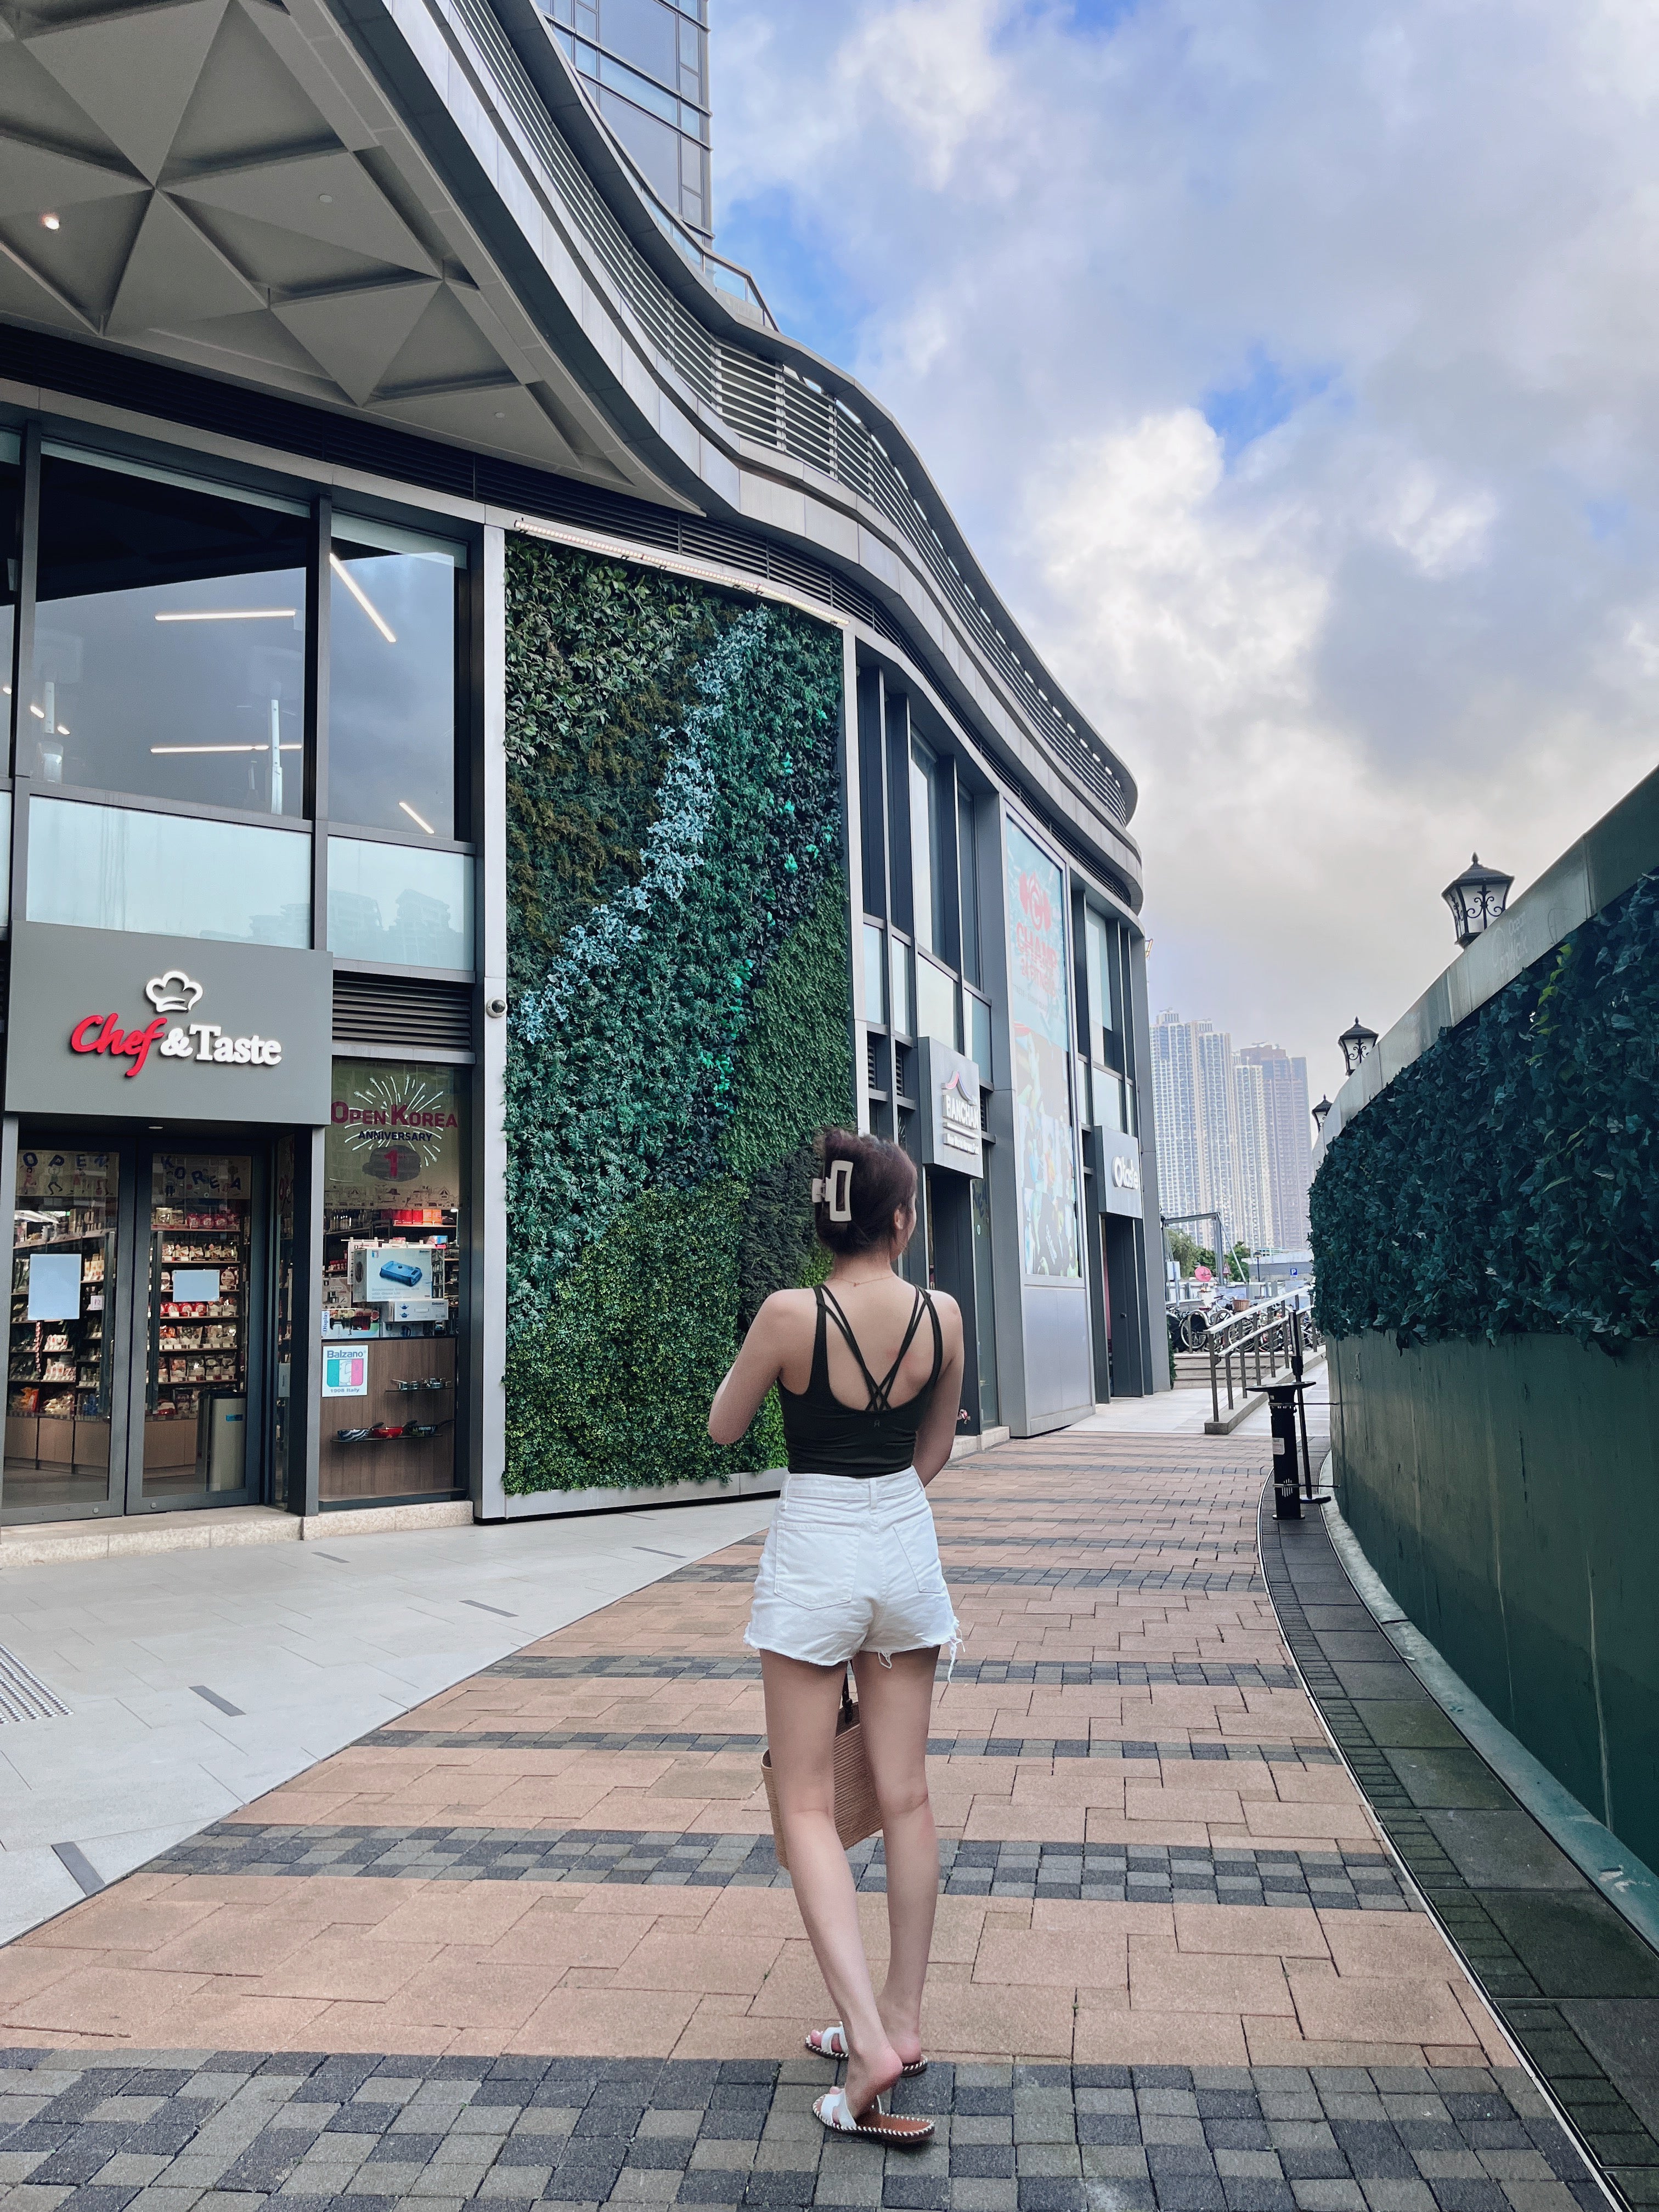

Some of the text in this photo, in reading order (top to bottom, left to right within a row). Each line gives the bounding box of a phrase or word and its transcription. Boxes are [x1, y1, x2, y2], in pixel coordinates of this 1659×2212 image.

[71, 1013, 167, 1077] Chef
[331, 1101, 458, 1128] OPEN KOREA
[945, 1094, 979, 1130] BANCHAN
[358, 1130, 433, 1142] ANNIVERSARY
[327, 1350, 363, 1358] Balzano
